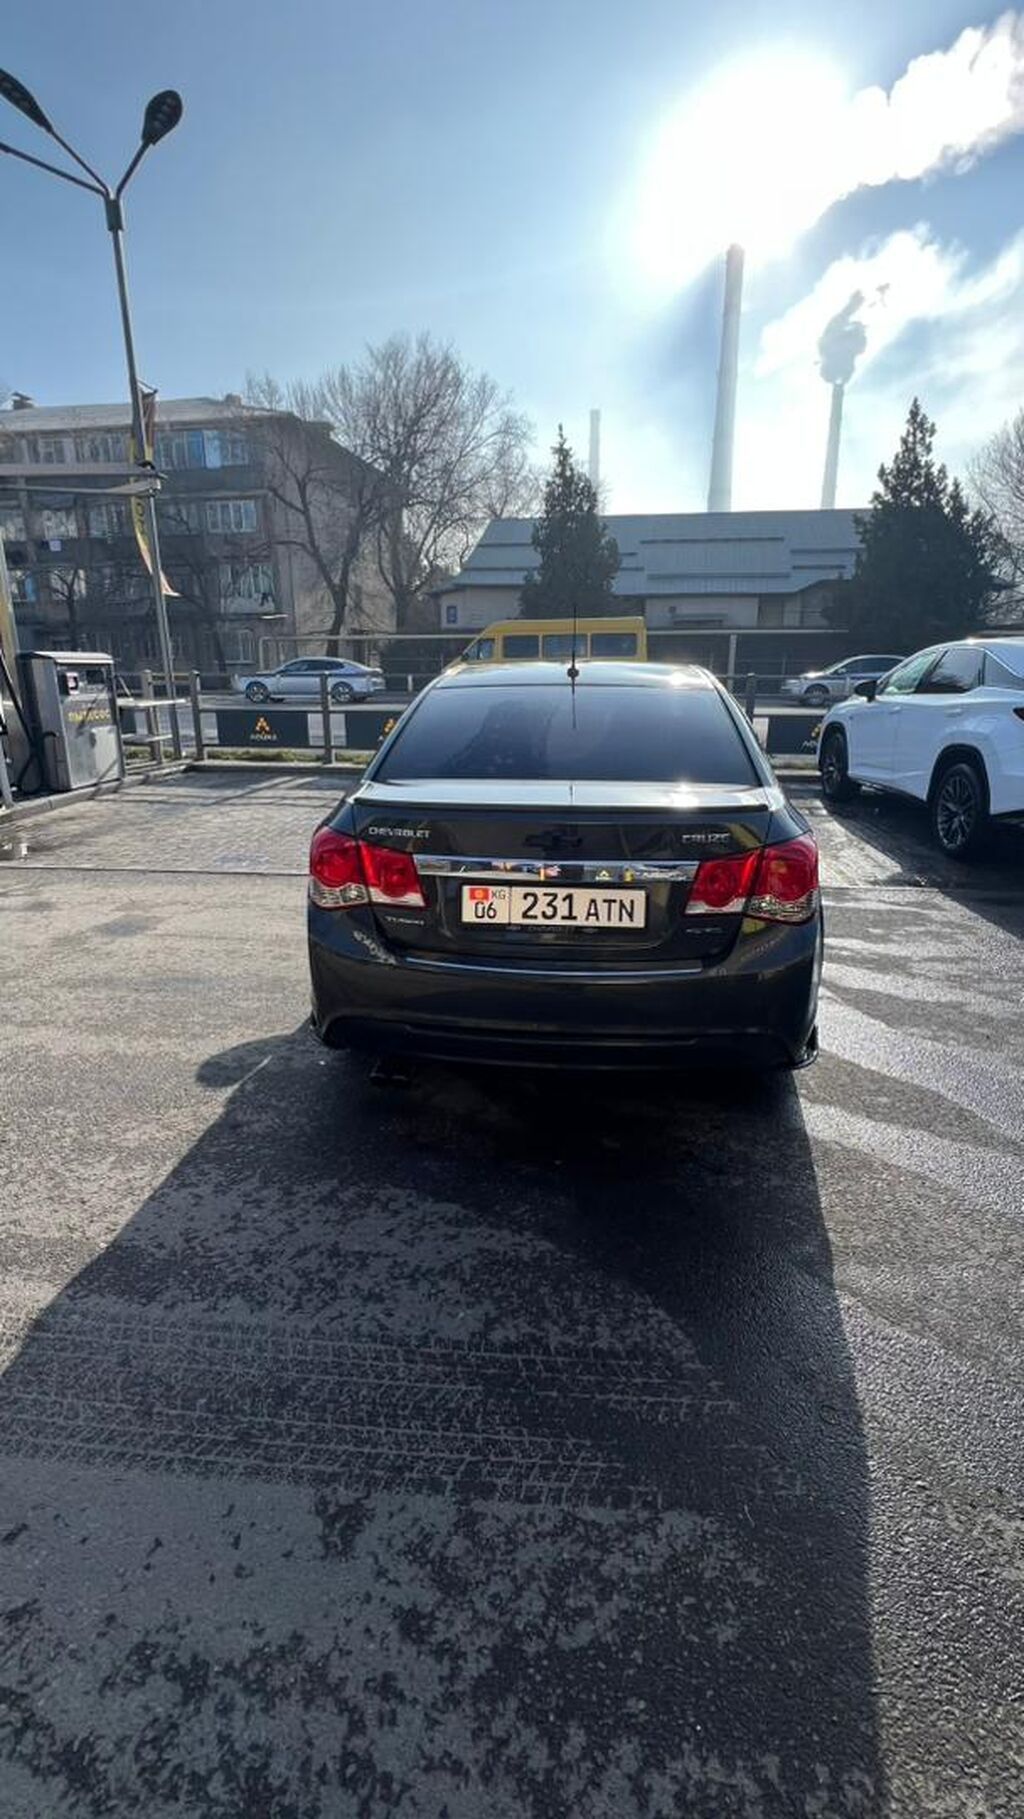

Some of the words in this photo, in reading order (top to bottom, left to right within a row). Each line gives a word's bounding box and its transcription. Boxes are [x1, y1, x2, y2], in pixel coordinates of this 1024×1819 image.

[368, 826, 431, 838] CHEVROLET
[490, 889, 506, 900] KG
[474, 901, 497, 919] 06
[521, 892, 578, 920] 231
[585, 898, 635, 922] ATN
